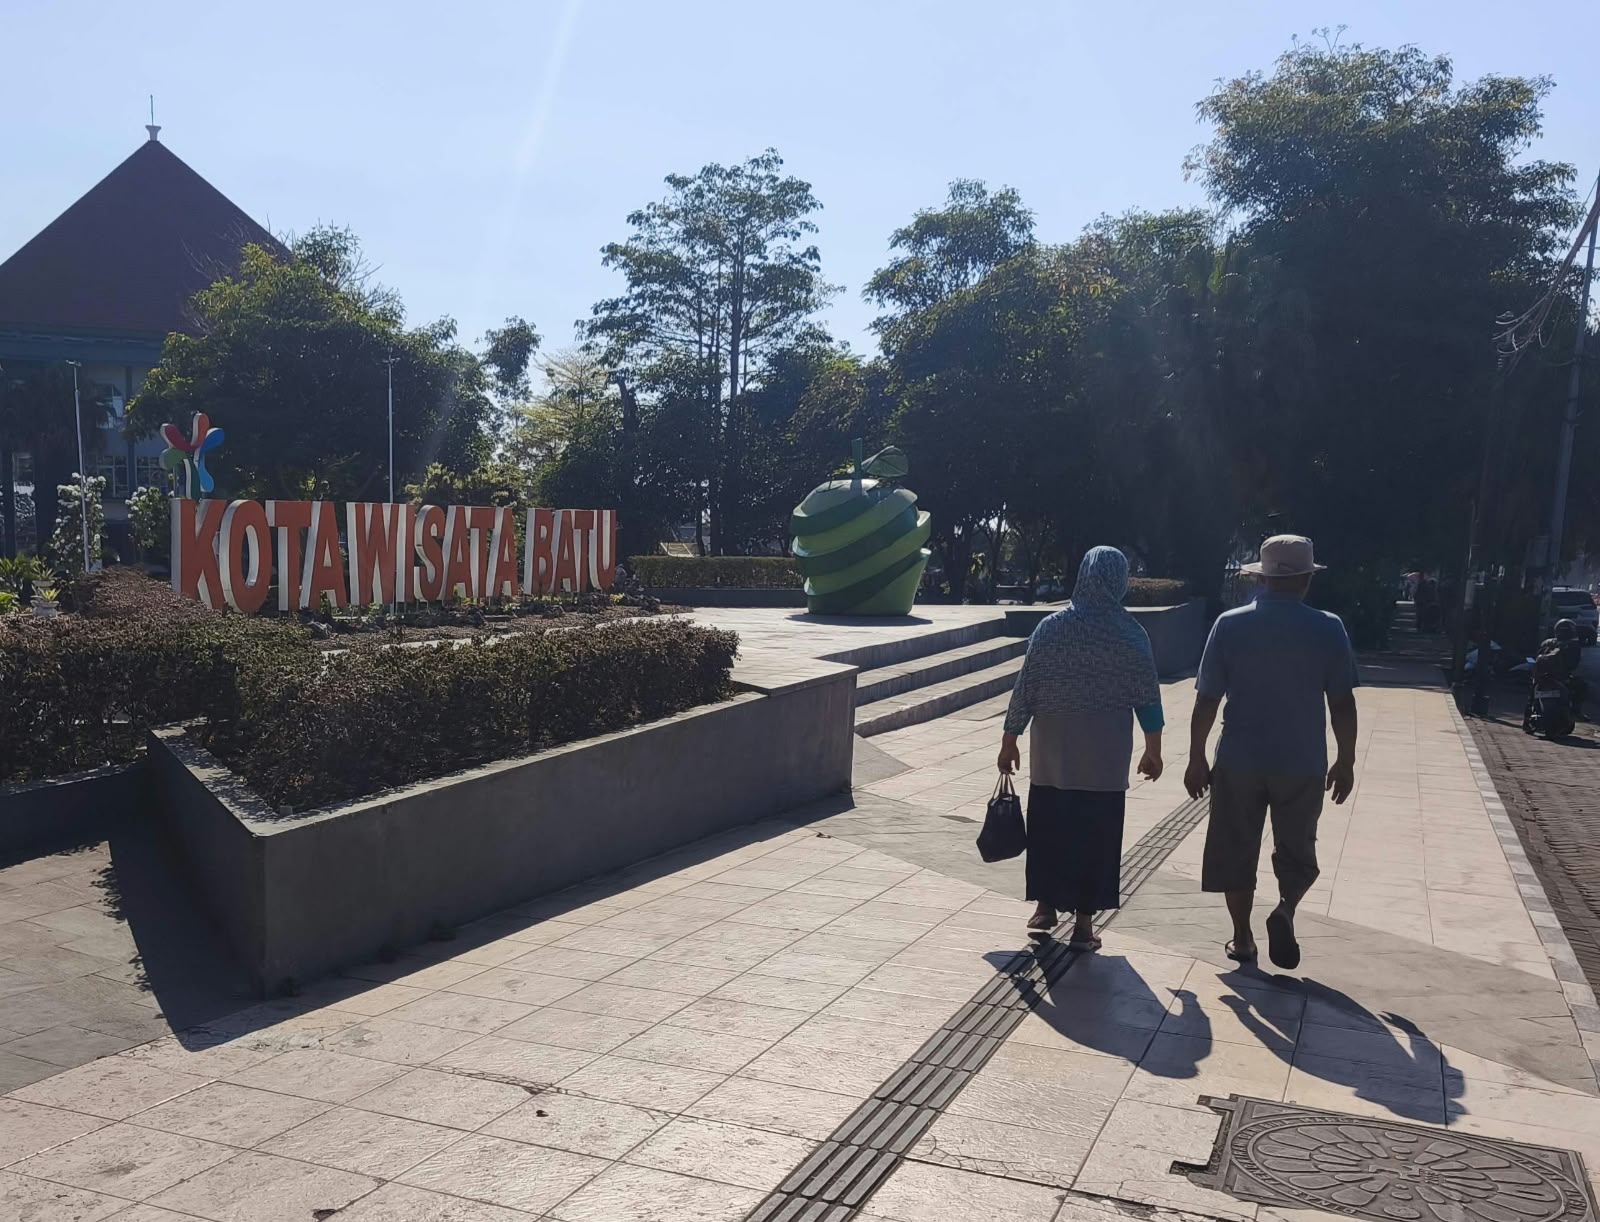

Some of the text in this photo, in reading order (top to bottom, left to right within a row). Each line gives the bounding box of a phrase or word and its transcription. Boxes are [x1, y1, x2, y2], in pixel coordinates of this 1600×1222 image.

[171, 499, 616, 613] KOTA WISATA BATU
